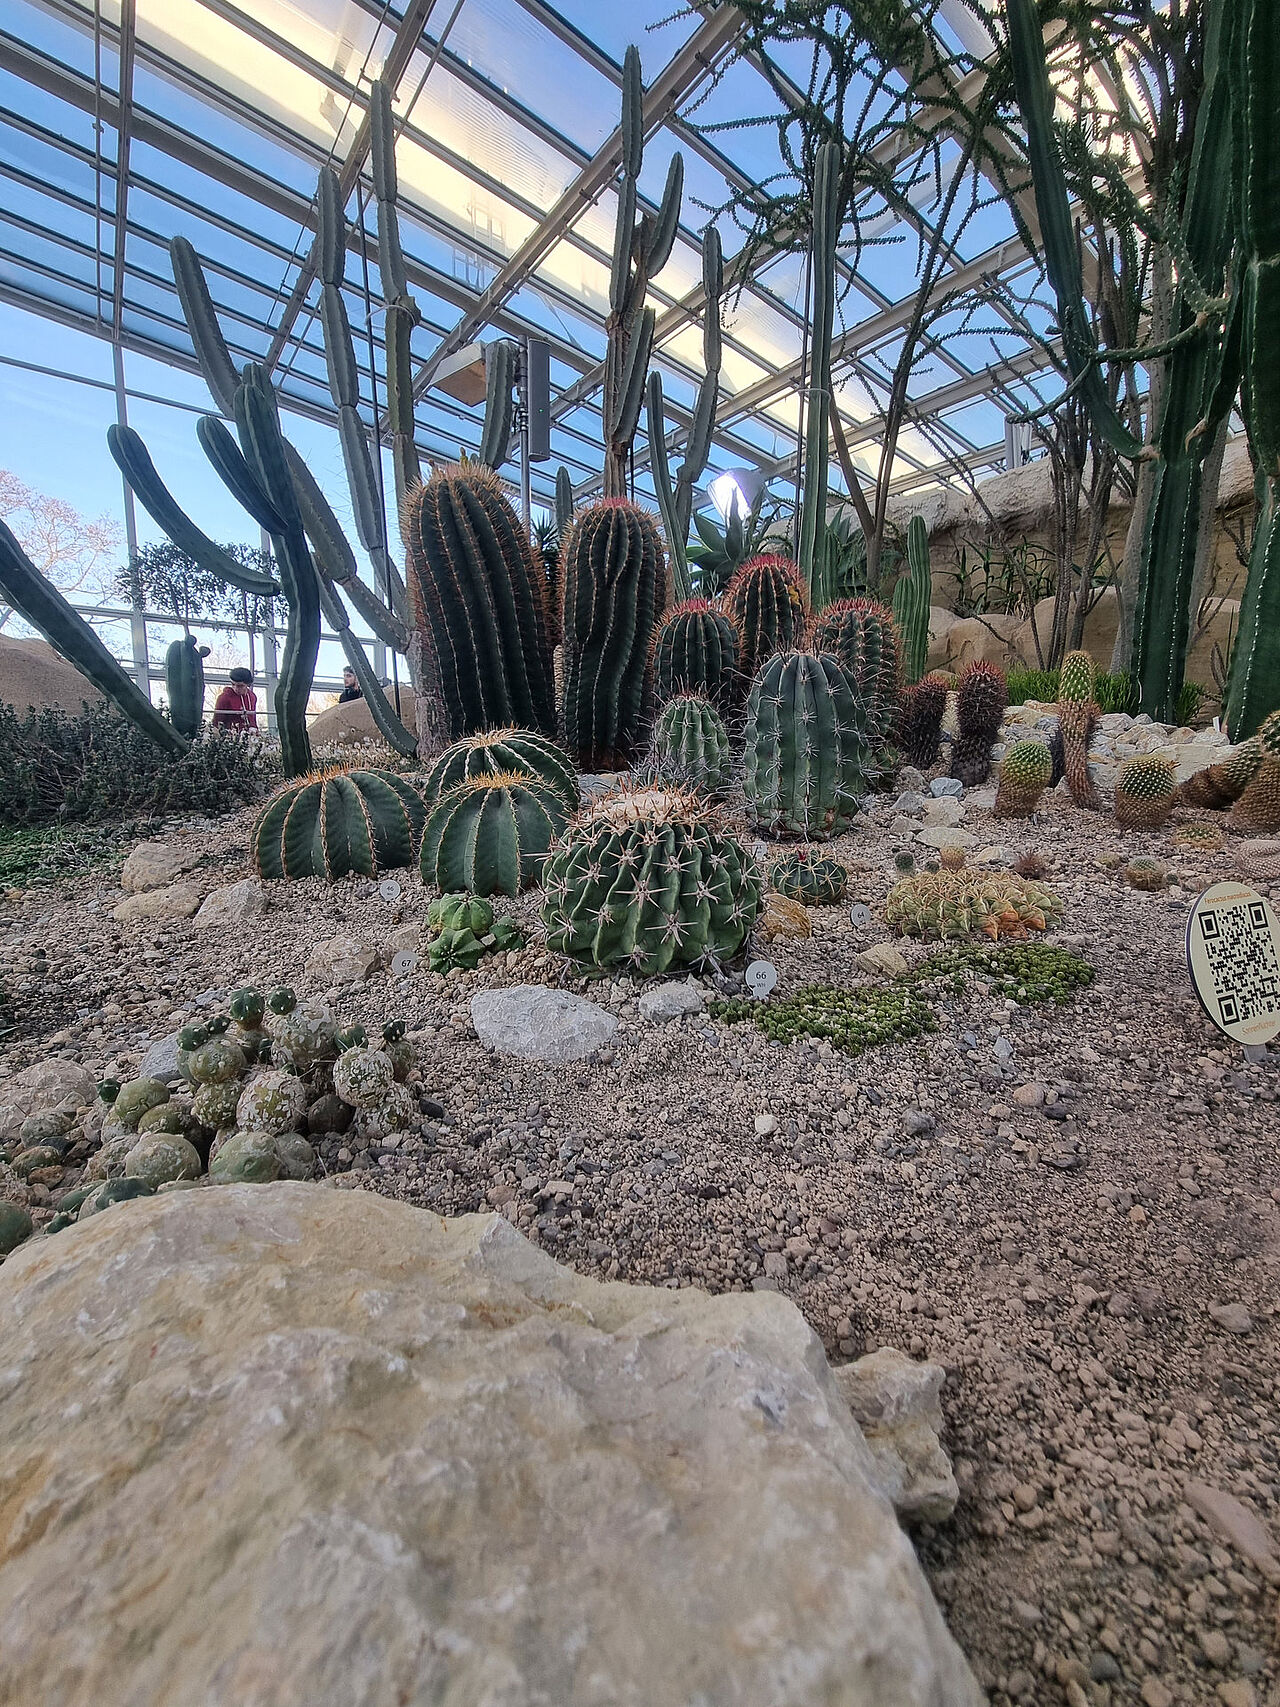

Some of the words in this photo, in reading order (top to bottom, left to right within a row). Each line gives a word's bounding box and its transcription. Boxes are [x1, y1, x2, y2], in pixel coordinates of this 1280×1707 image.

[857, 911, 864, 919] 64
[401, 959, 411, 968] 67
[755, 971, 767, 980] 66
